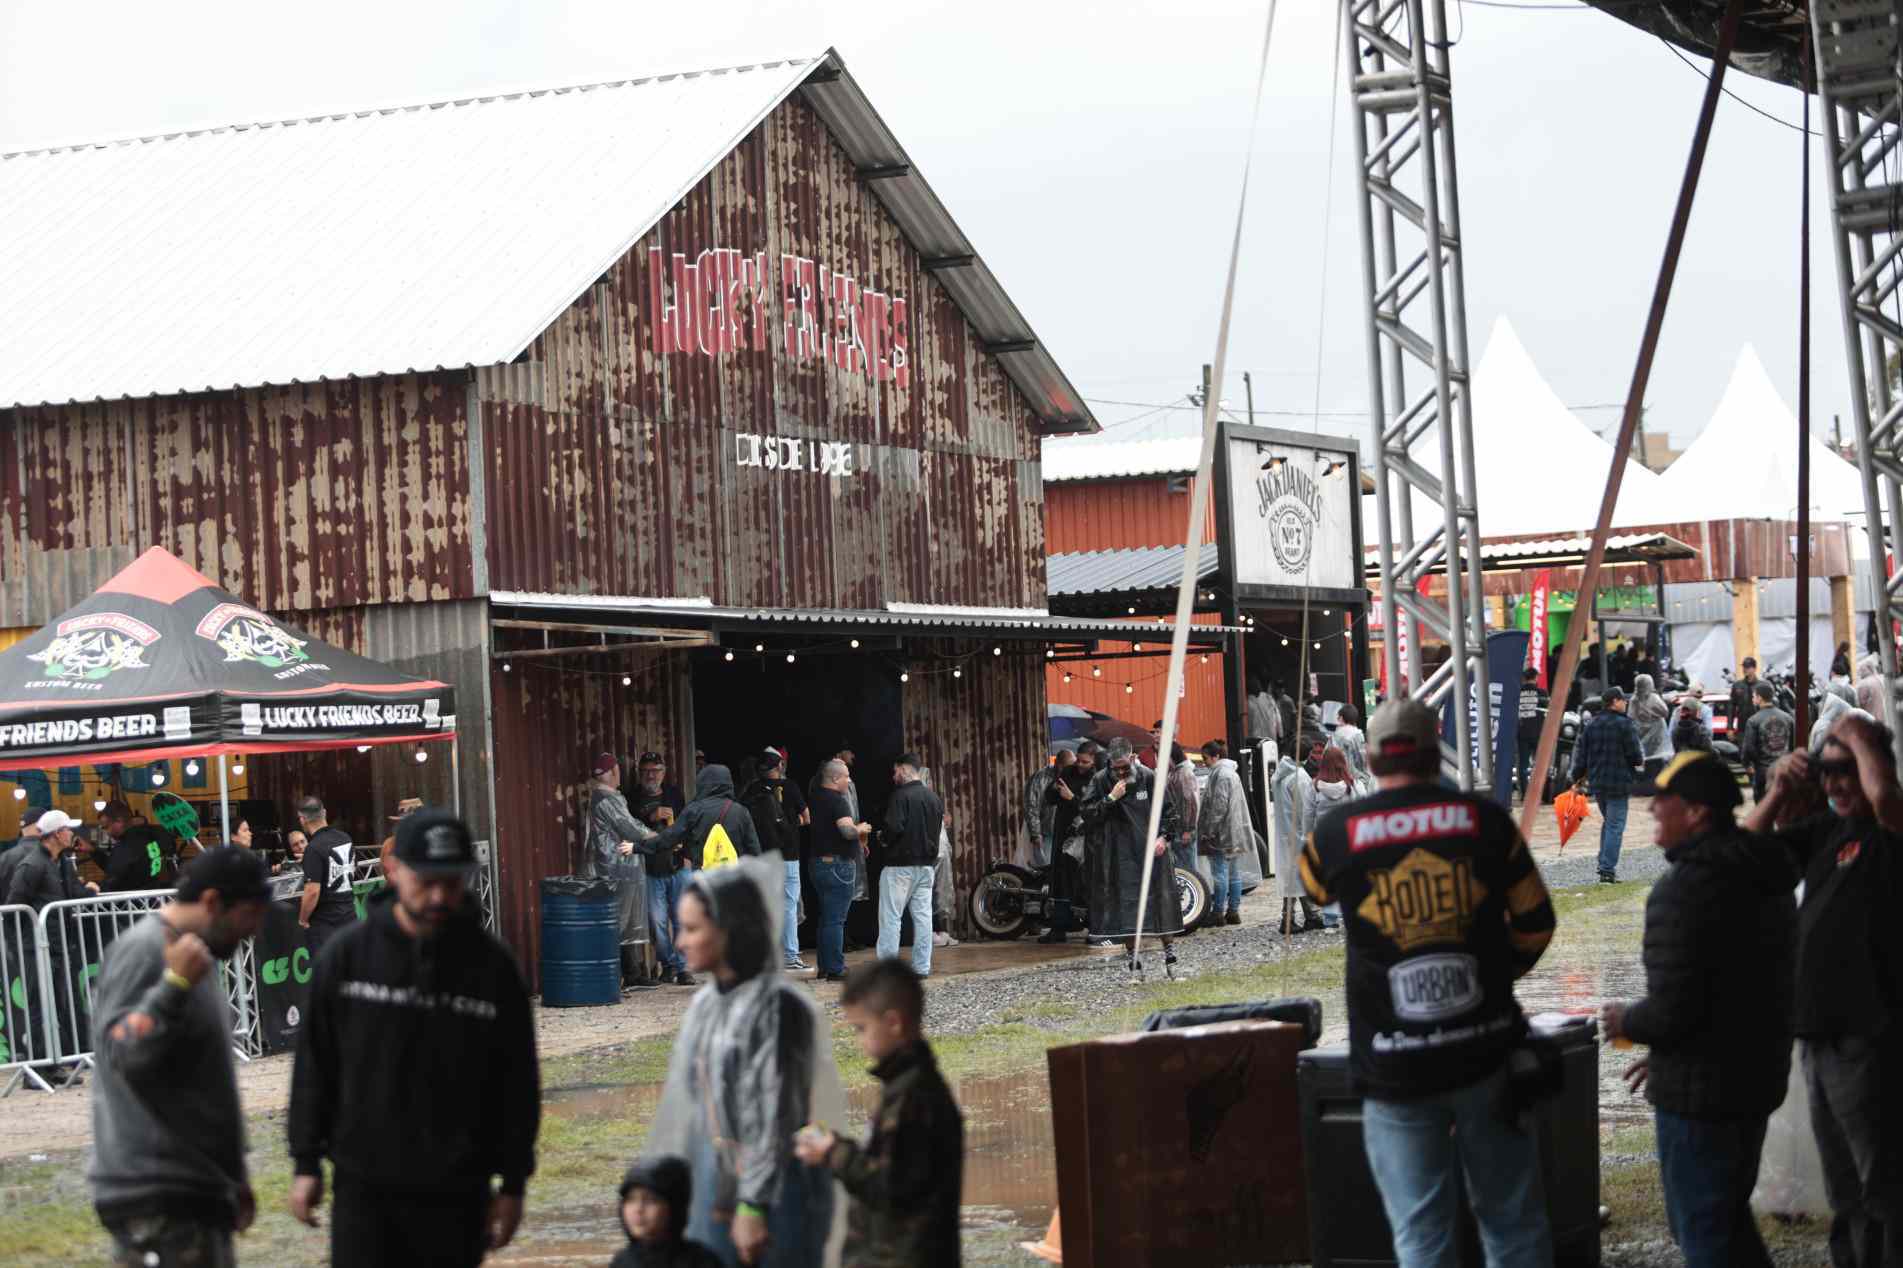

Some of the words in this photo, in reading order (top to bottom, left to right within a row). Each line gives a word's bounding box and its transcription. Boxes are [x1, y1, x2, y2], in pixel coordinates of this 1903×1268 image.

[648, 246, 769, 356] LUCKY
[736, 433, 803, 470] DESDE
[1532, 586, 1546, 674] MOTUL
[0, 718, 94, 747] FRIENDS
[97, 713, 157, 740] BEER
[264, 704, 317, 729] LUCKY
[318, 703, 384, 728] FRIENDS
[384, 704, 422, 723] BEER
[1353, 804, 1474, 846] MOTUL
[1402, 964, 1472, 1005] URBAN
